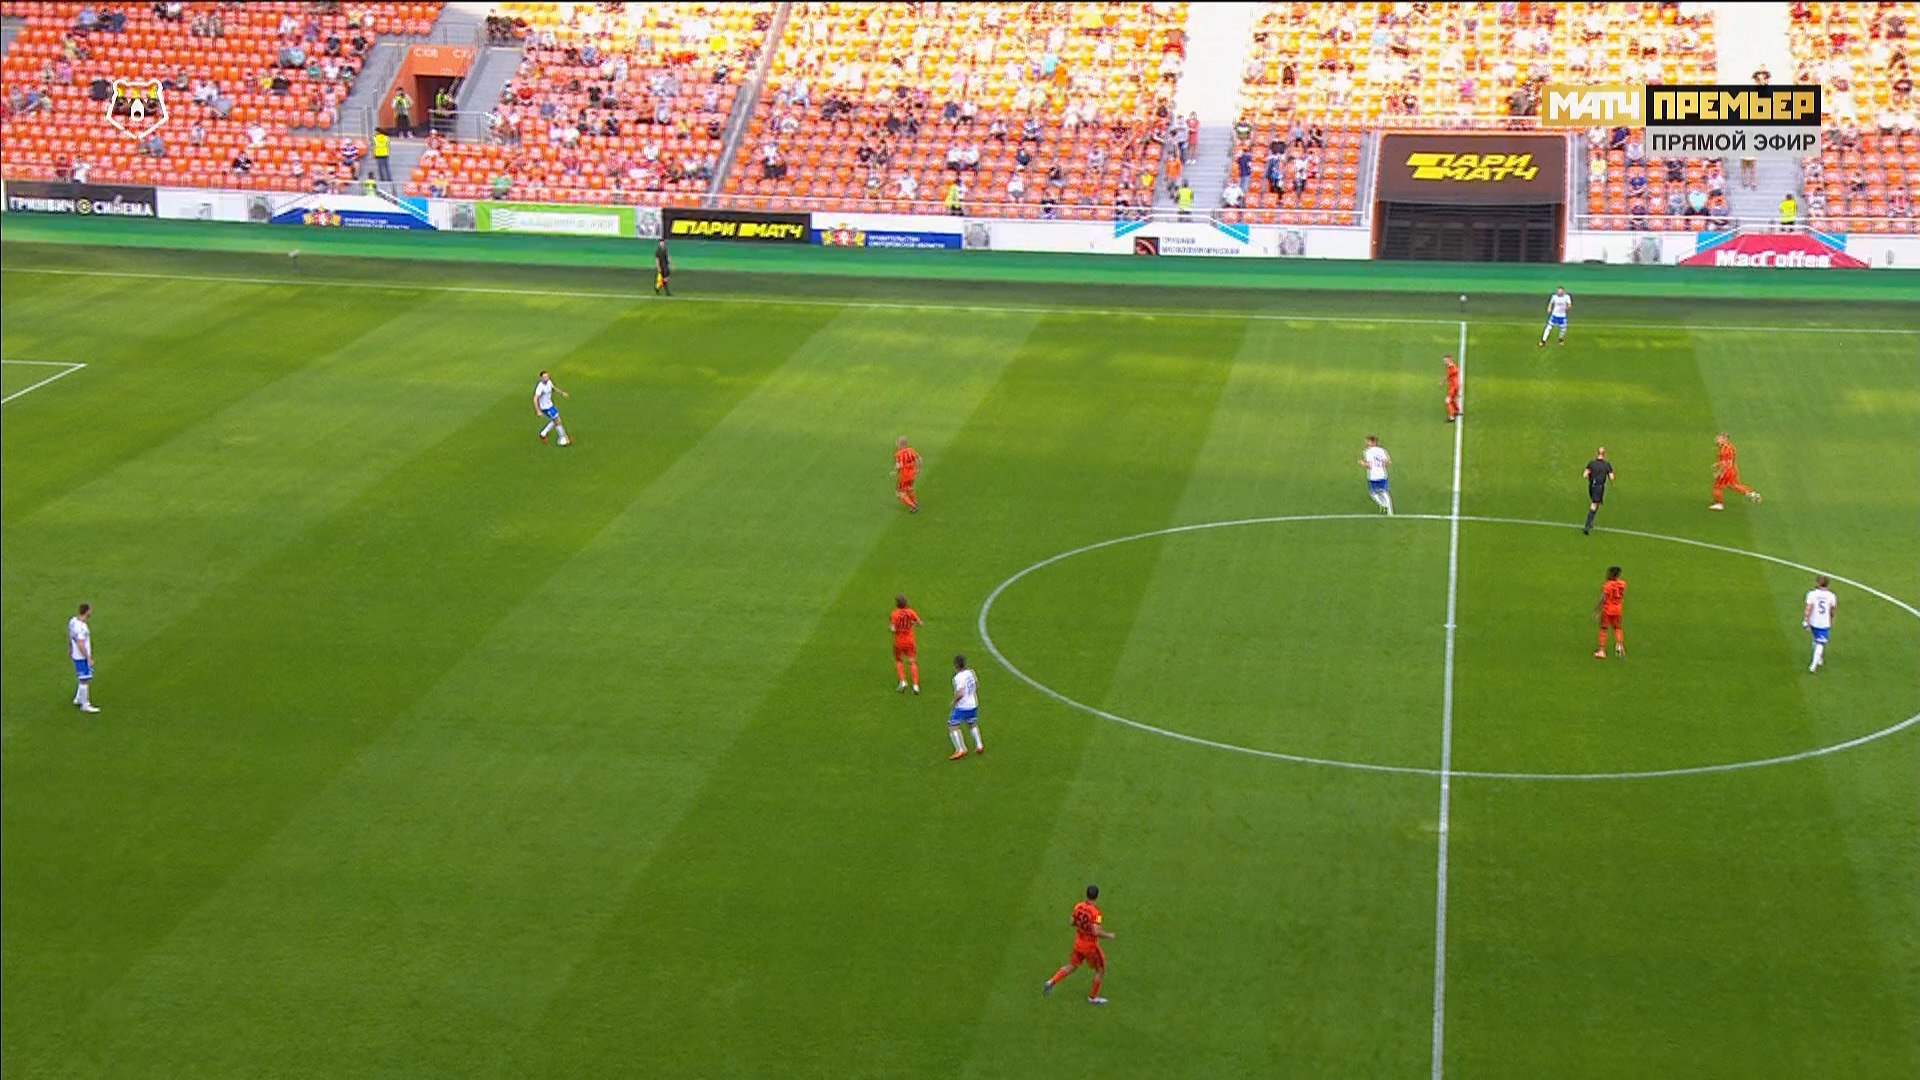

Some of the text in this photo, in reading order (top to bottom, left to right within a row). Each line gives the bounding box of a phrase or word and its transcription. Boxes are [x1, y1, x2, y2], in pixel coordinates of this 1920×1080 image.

[1406, 153, 1533, 167] ПАРИ
[1412, 167, 1539, 180] МАТЧ
[672, 220, 804, 239] ПАРИ МАТЧ
[1818, 600, 1826, 615] 5
